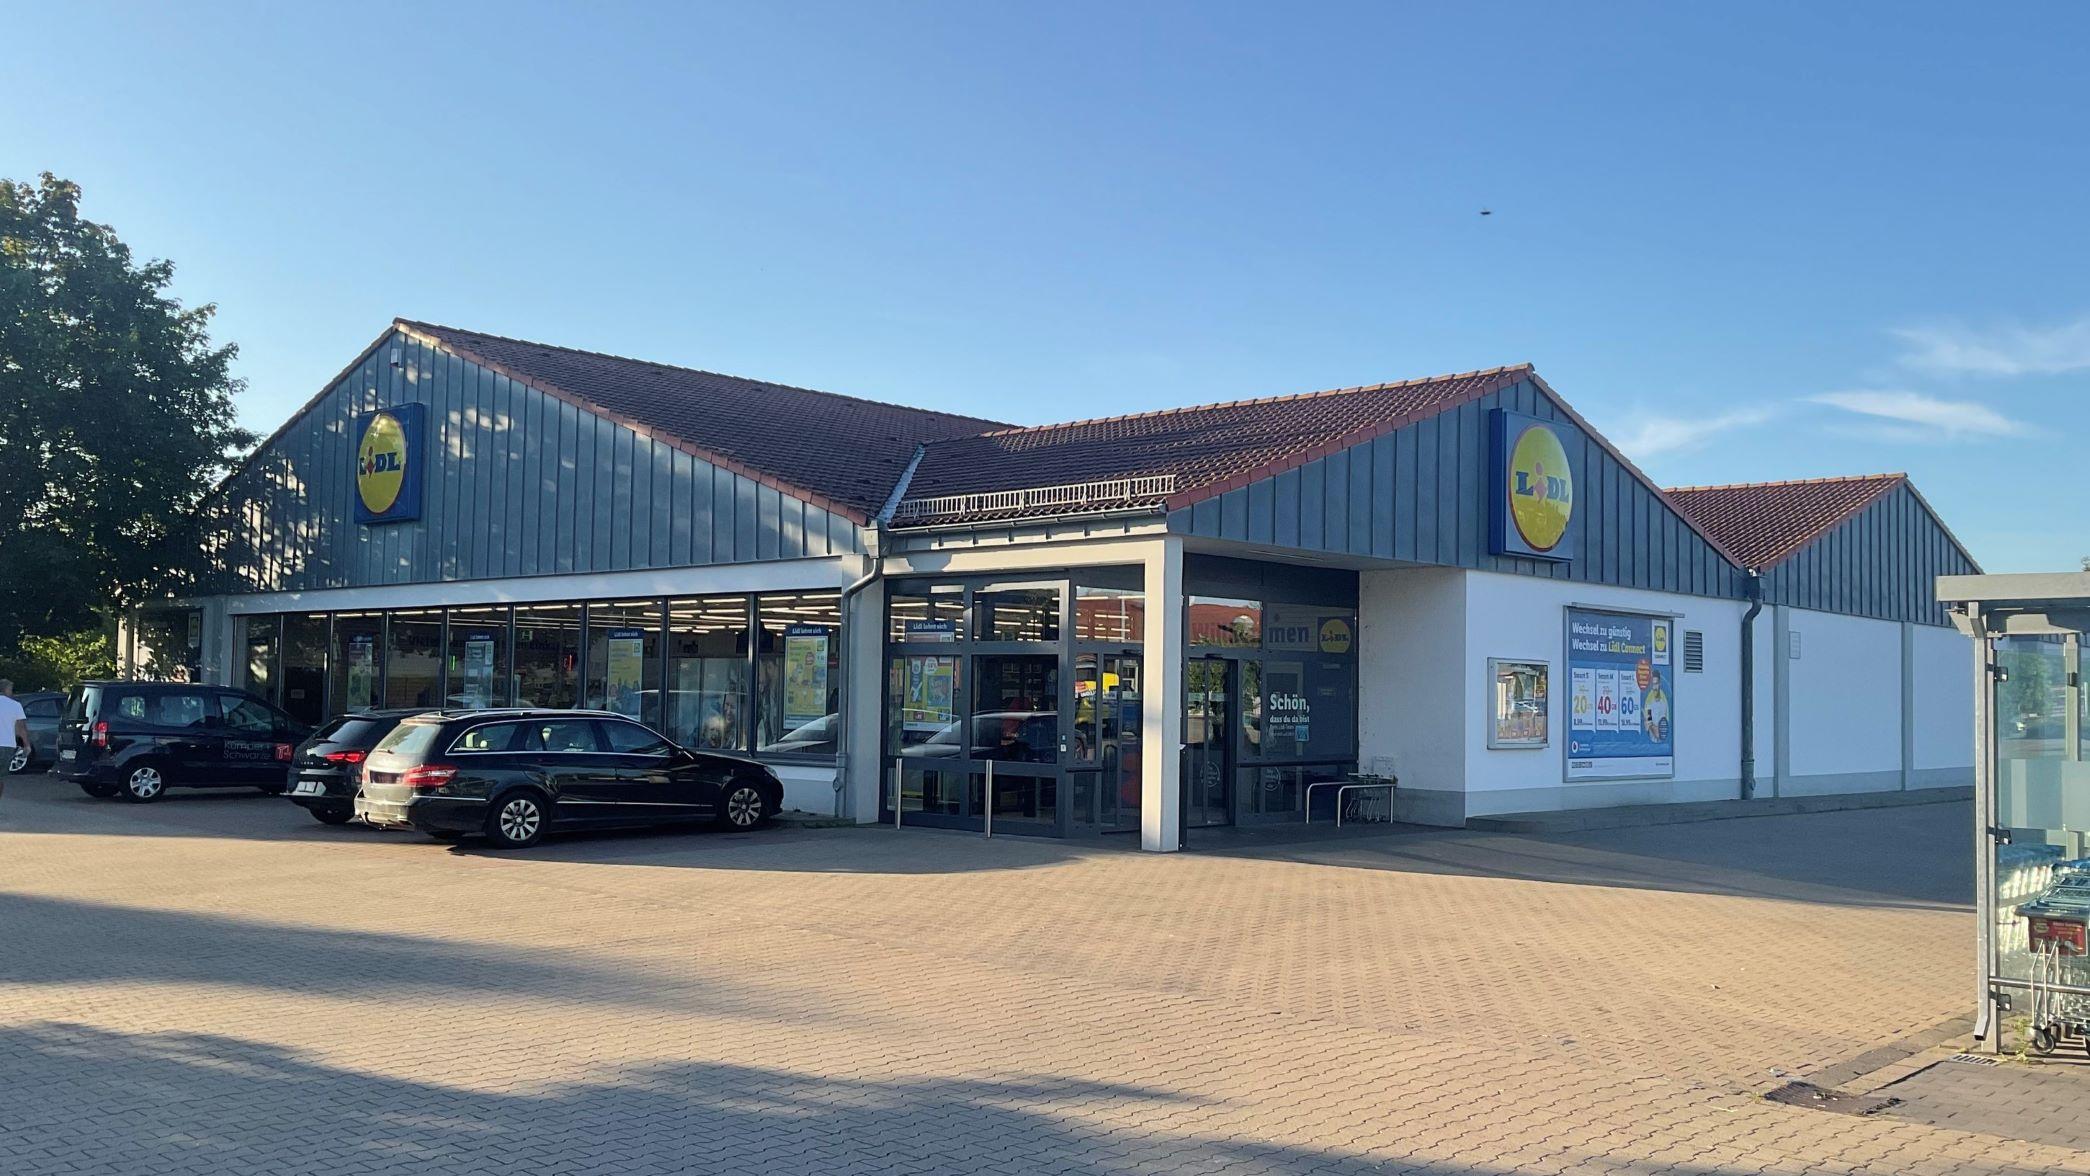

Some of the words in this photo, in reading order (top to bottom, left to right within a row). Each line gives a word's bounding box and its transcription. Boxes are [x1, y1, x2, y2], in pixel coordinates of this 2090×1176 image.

[1572, 622, 1599, 635] Wechsel
[1600, 627, 1607, 636] zu
[1608, 626, 1632, 641] günstig
[1572, 638, 1599, 651] Wechsel
[1600, 643, 1607, 652] zu
[1608, 641, 1620, 653] Lidl
[1621, 643, 1646, 654] Connect
[1270, 693, 1310, 713] Schön,
[1573, 695, 1587, 714] 20
[1598, 696, 1611, 714] 40
[1621, 696, 1634, 715] 60
[1270, 715, 1282, 723] dass
[1283, 715, 1290, 723] du
[1291, 715, 1299, 723] da
